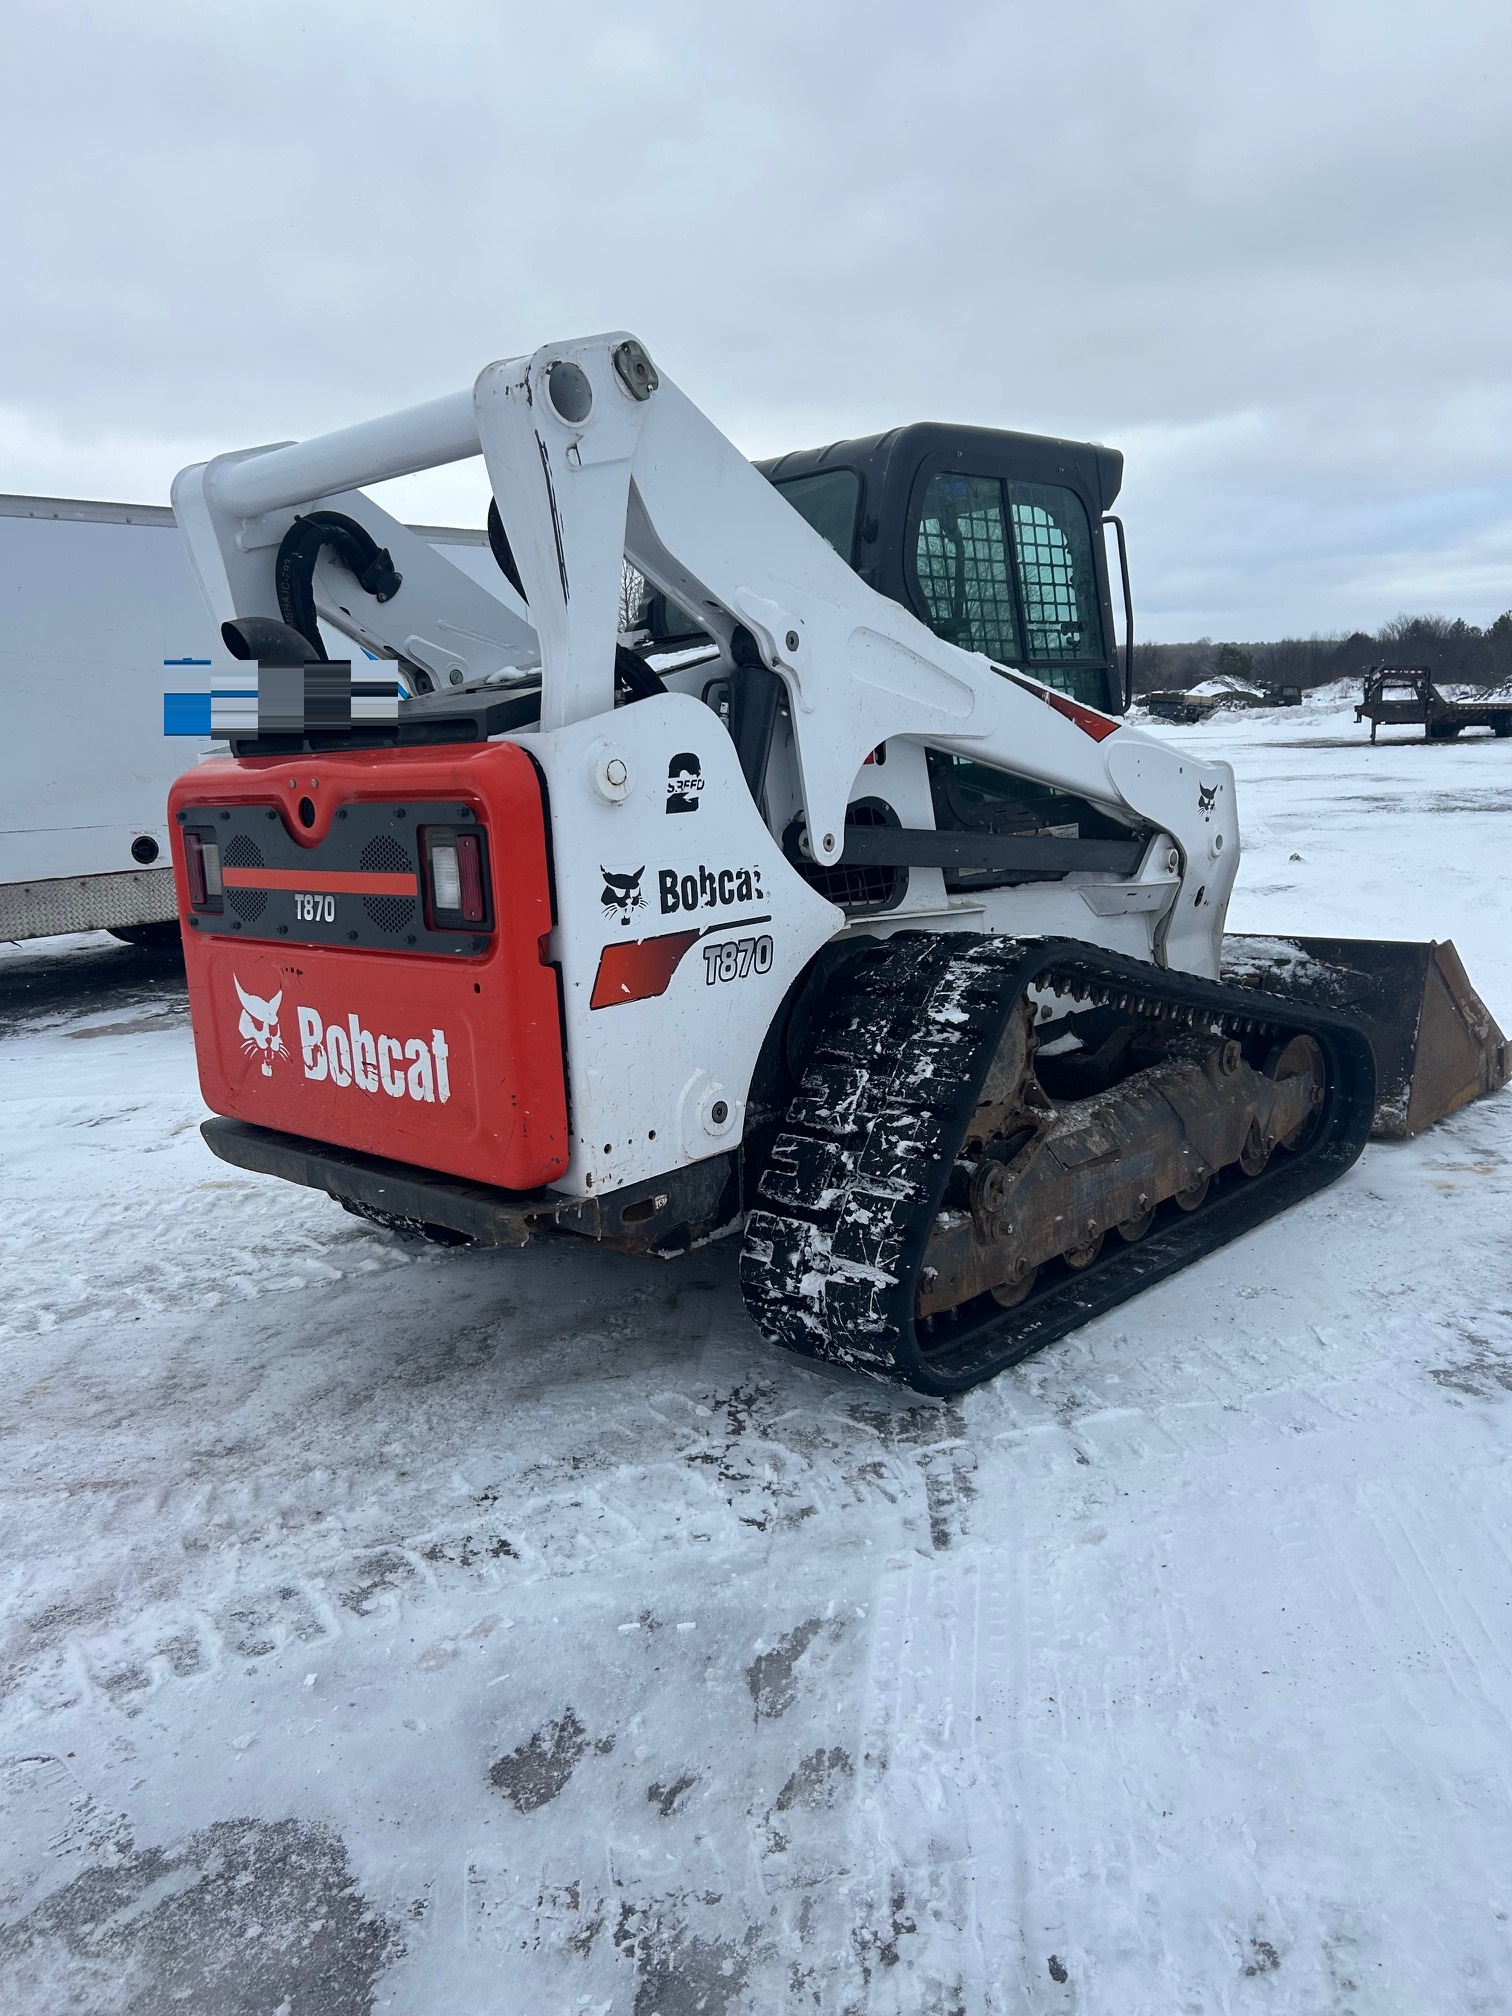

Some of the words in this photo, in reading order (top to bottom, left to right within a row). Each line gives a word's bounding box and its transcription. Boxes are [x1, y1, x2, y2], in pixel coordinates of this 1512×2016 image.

[294, 893, 335, 923] T870
[703, 935, 773, 985] T870
[297, 1006, 450, 1104] Bobcat
